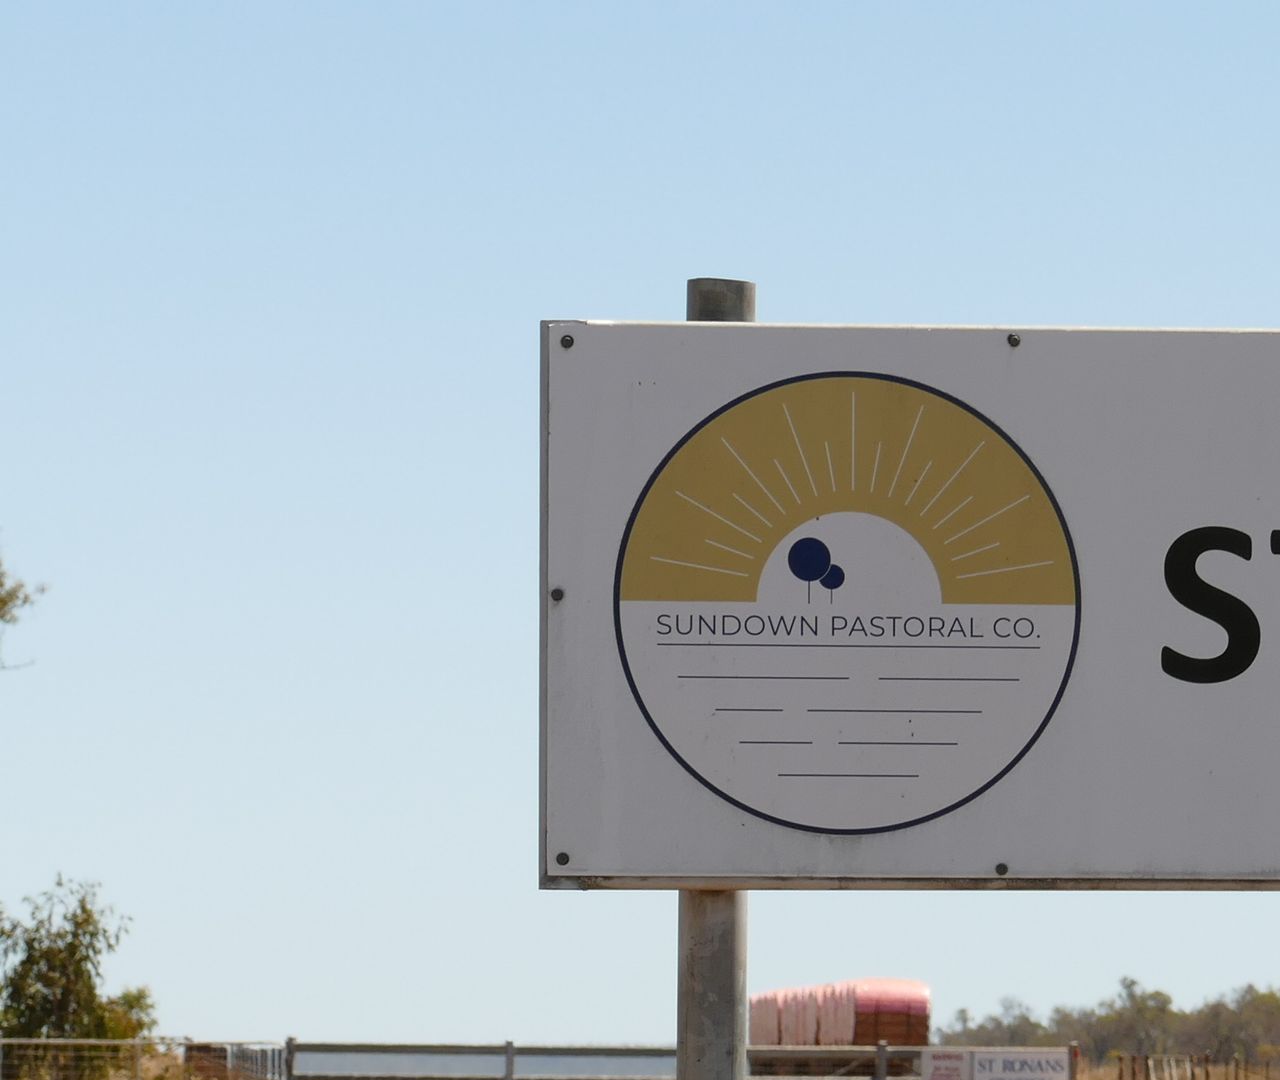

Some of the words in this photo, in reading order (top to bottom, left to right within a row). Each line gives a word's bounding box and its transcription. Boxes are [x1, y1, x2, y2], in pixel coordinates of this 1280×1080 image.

[656, 613, 819, 637] SUNDOWN
[830, 615, 984, 639] PASTORAL
[992, 616, 1041, 639] CO.
[977, 1058, 995, 1073] ST
[1002, 1058, 1064, 1073] RONANS
